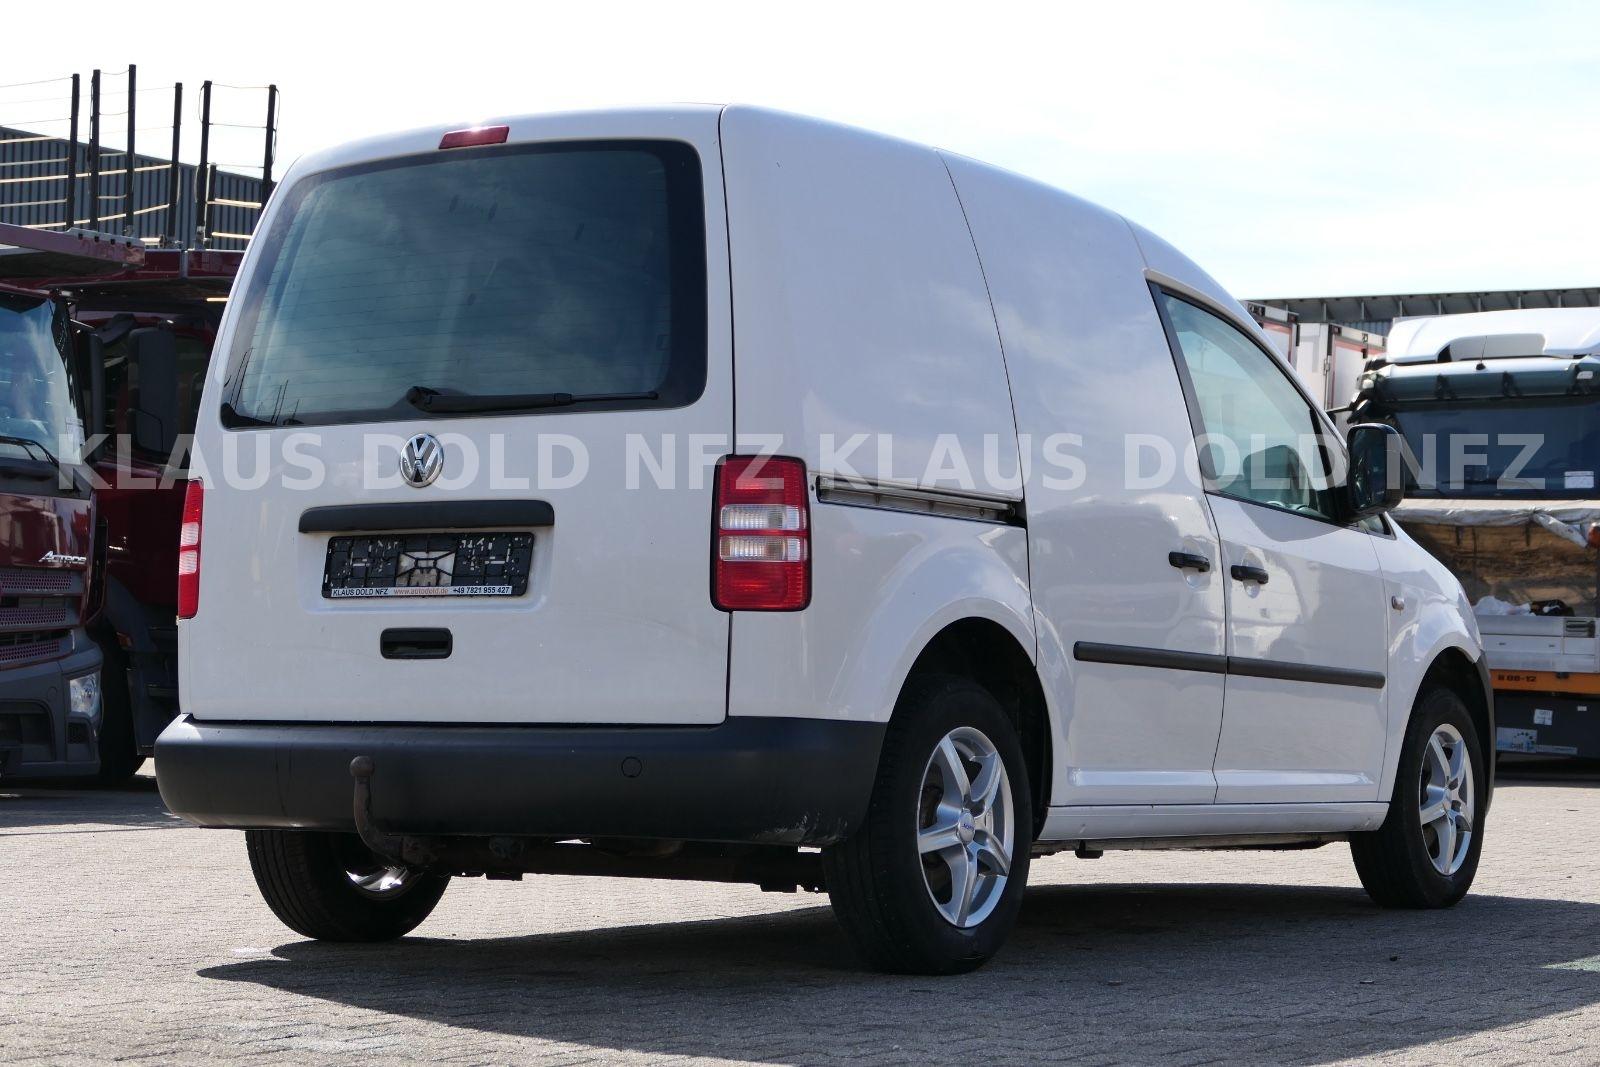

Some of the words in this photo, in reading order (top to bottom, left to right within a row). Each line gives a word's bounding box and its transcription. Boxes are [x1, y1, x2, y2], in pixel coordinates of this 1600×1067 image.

[332, 588, 355, 597] KLAUS
[355, 588, 374, 596] DOLD
[375, 587, 389, 595] NFZ
[466, 586, 482, 594] 7821
[483, 586, 496, 594] 955
[497, 586, 510, 594] 427
